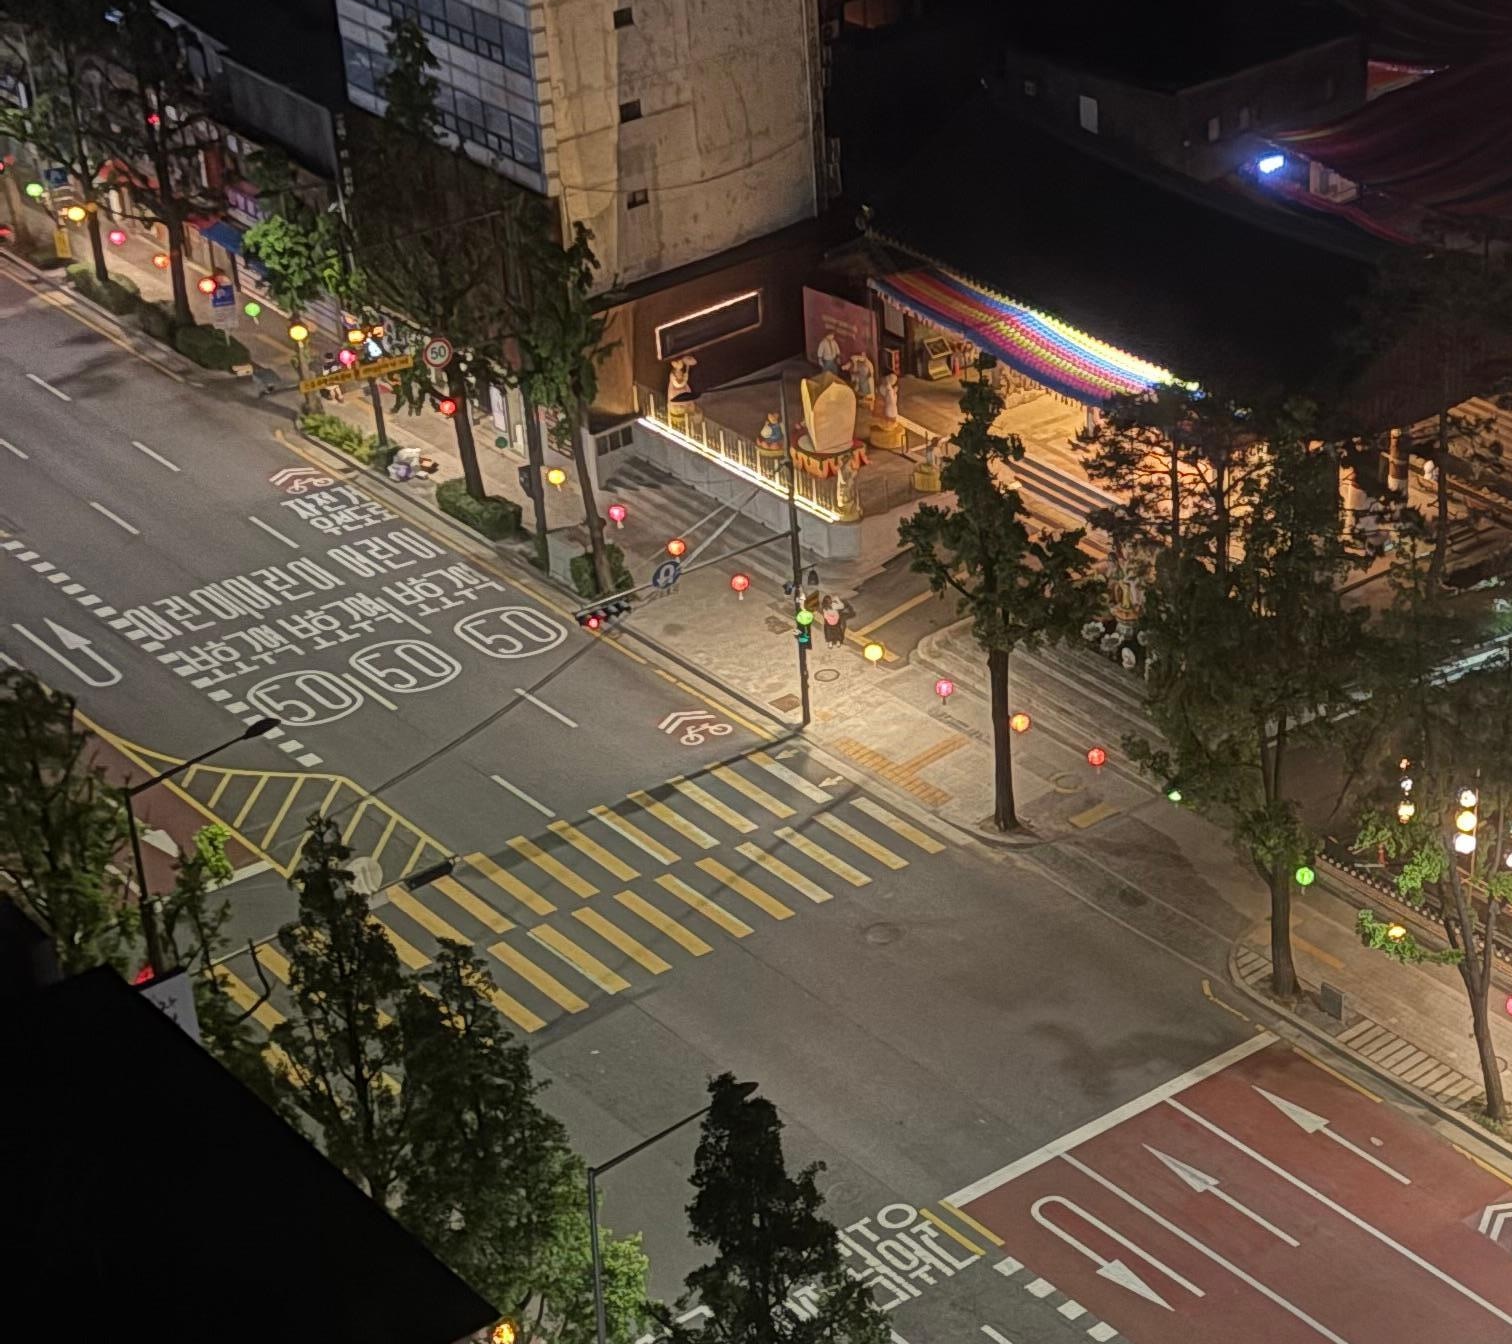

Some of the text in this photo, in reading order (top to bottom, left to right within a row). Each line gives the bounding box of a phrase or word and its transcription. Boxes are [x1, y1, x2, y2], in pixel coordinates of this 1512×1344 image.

[280, 485, 371, 519] 자전거
[309, 501, 400, 536] 우선도로
[122, 527, 448, 641] 어린이 어린이 어린이
[175, 561, 508, 685] 보호구역 보호구역 보호구역
[255, 609, 555, 723] 50 50 50
